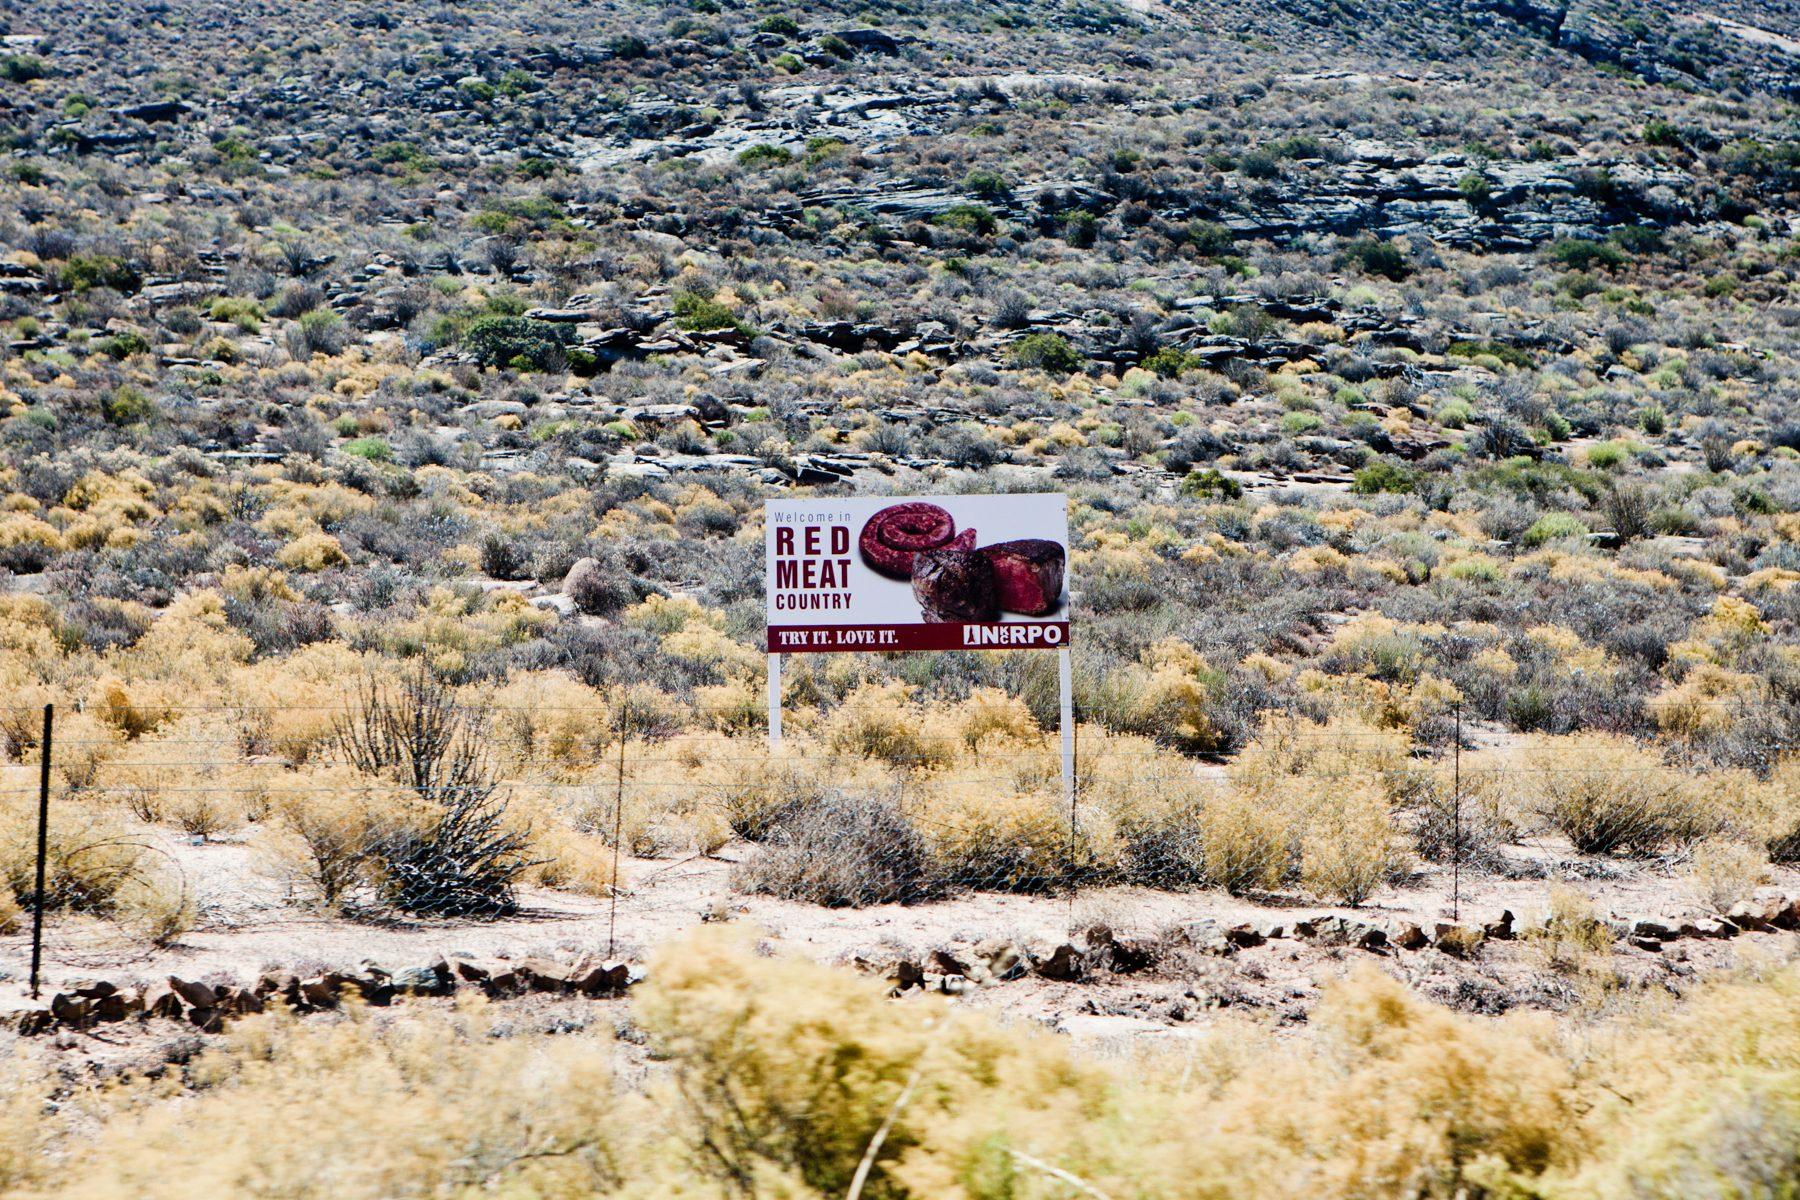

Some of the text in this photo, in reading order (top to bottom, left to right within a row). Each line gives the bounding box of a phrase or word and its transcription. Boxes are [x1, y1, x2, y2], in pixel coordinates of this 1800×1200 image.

[775, 511, 851, 523] Welcome in
[776, 526, 850, 556] RED
[776, 559, 851, 589] MEAT
[776, 593, 852, 610] COUNTRY
[779, 629, 899, 645] TRY IT. LOVE IT.
